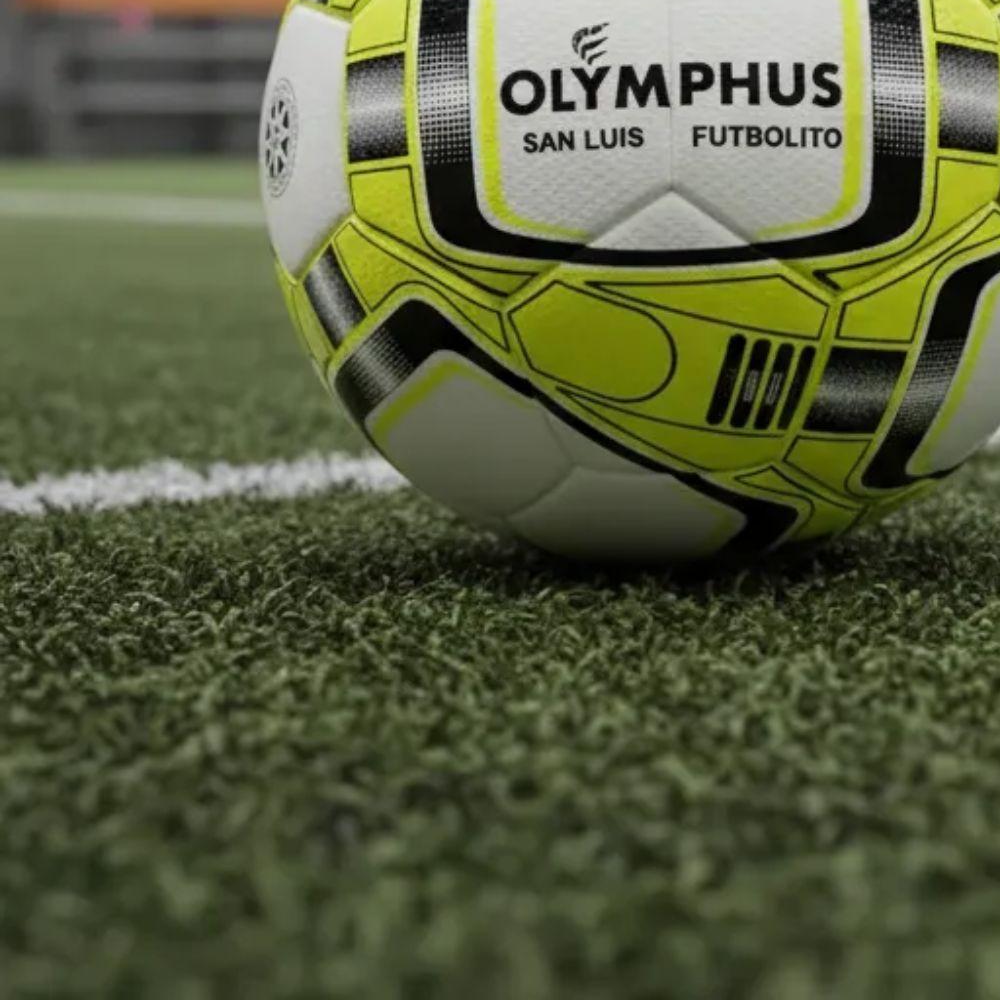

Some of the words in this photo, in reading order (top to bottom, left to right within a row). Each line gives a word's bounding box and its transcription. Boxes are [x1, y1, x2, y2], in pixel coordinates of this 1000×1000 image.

[499, 61, 842, 116] OLYMPHUS
[522, 130, 576, 154] SAN
[584, 126, 645, 150] LUIS
[692, 125, 843, 149] FUTBOLITO
